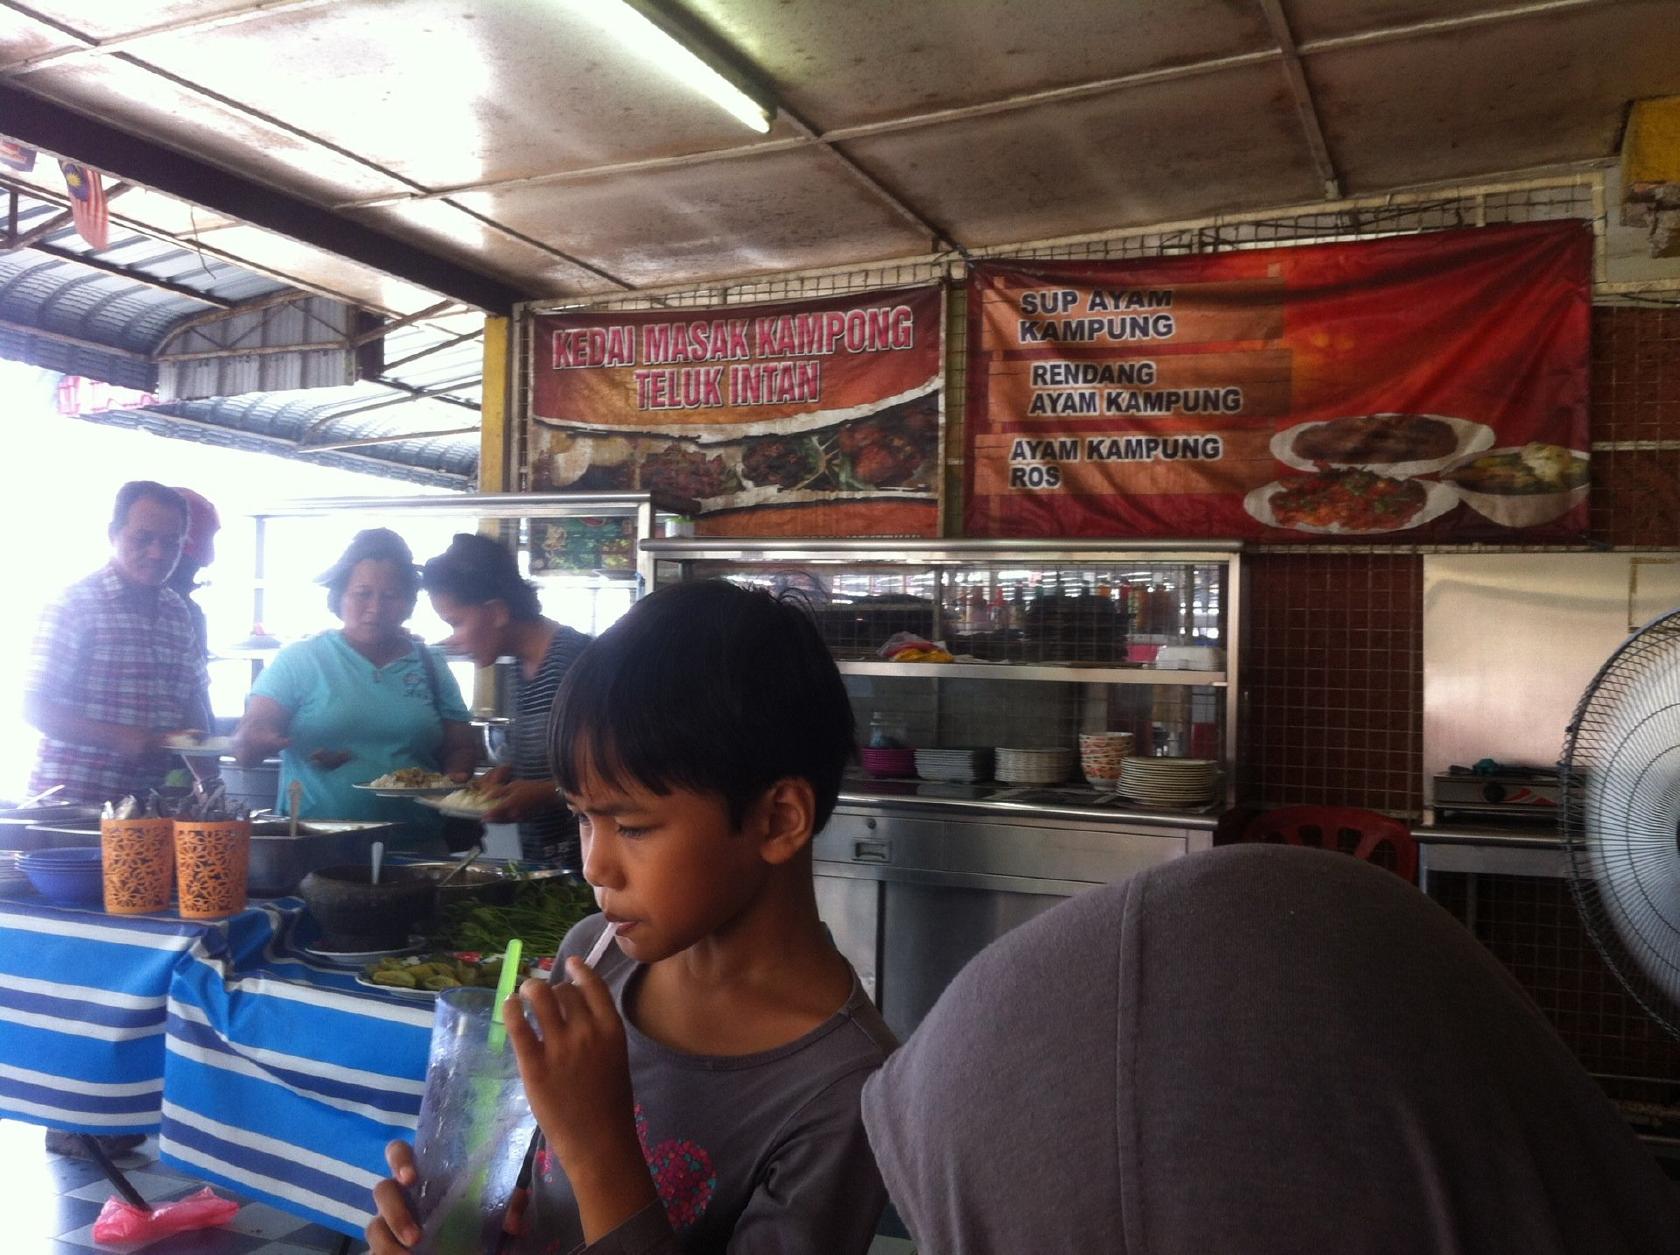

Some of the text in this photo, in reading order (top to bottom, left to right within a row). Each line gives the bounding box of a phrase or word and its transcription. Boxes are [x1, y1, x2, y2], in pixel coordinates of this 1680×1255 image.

[1021, 289, 1173, 315] SUP AYAM
[553, 306, 913, 369] KEDAI MASAK KAMPONG
[1019, 314, 1174, 343] KAMPUNG
[635, 360, 819, 410] TELUK INTAN
[1031, 362, 1156, 387] RENDANG
[1028, 388, 1242, 415] AYAM KAMPUNG
[1010, 436, 1222, 462] AYAM KAMPUNG
[1010, 466, 1061, 488] ROS
